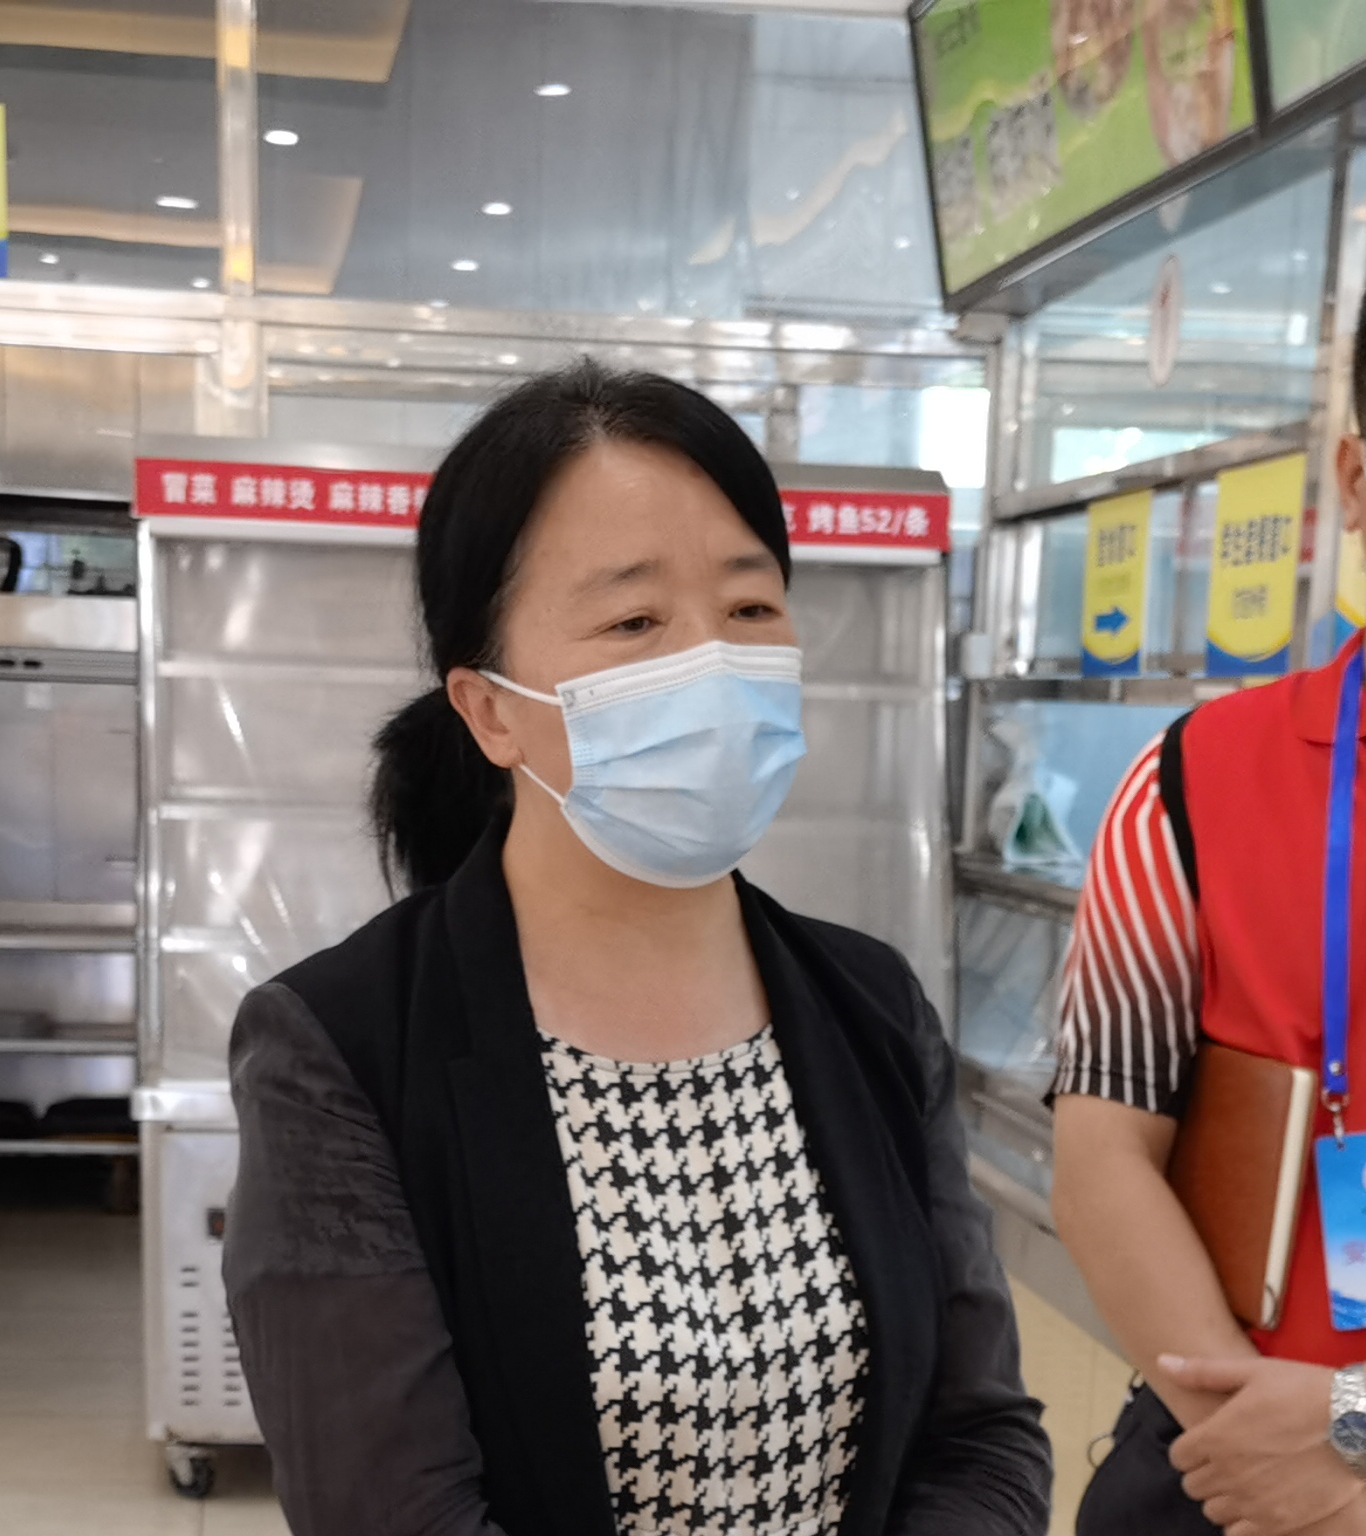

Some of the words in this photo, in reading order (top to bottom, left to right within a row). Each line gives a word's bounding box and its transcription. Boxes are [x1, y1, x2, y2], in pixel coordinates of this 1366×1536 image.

[162, 472, 217, 505] 冒菜
[231, 475, 315, 511] 麻辣烫
